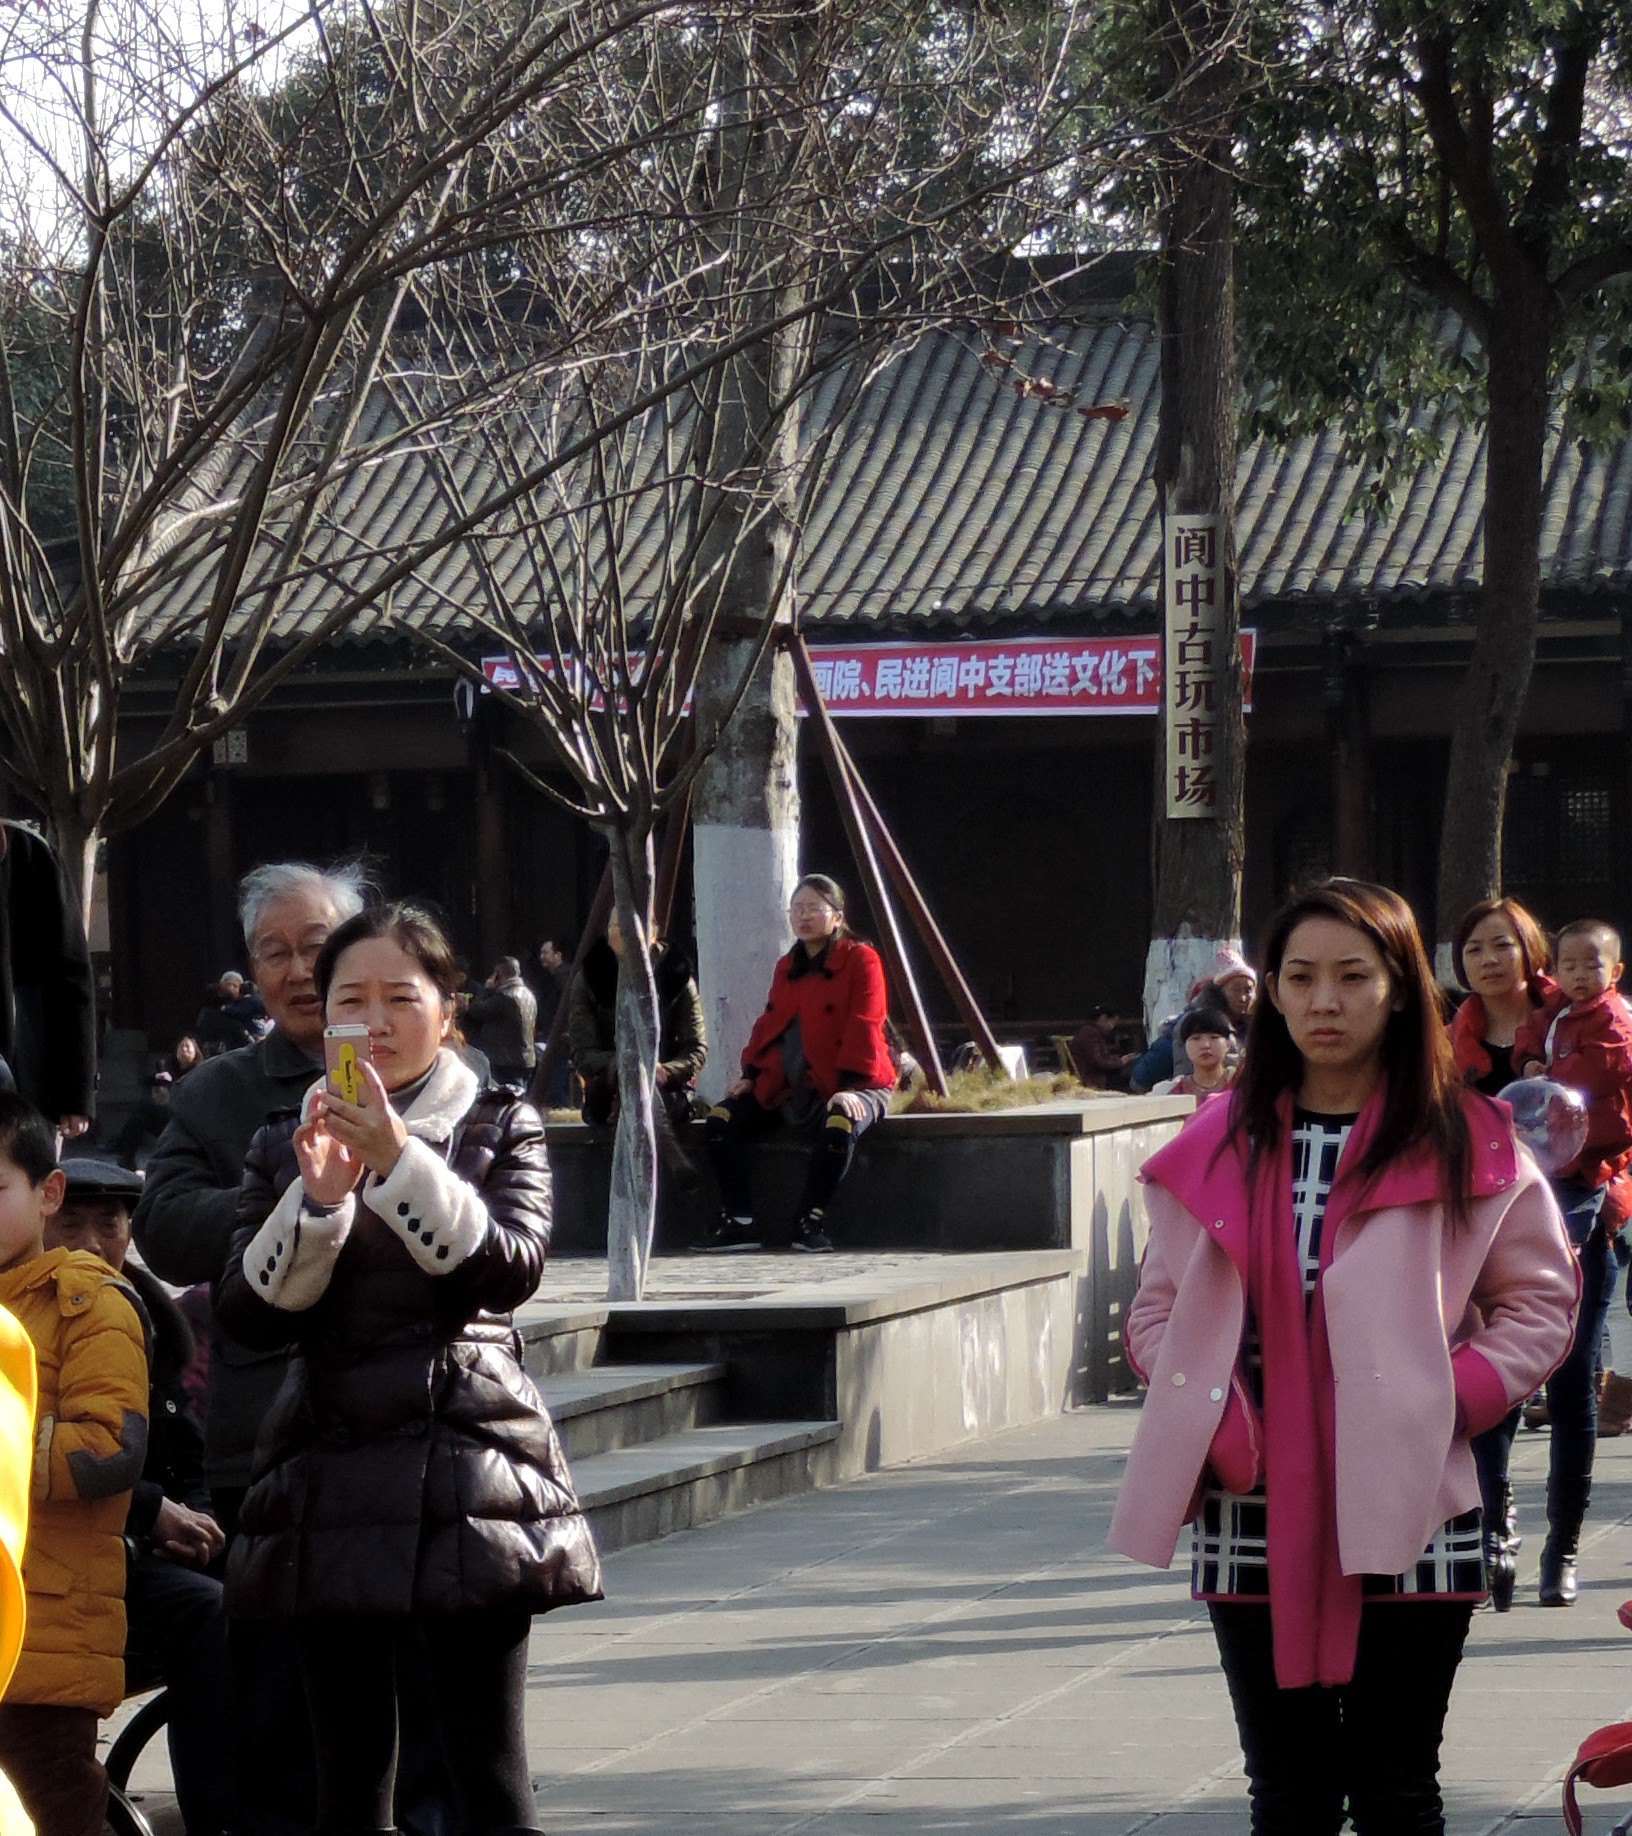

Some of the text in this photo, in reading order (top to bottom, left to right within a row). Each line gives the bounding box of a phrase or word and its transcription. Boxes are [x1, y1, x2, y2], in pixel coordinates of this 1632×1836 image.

[812, 649, 1159, 702] 画院、民进阆中支部送文化下
[1174, 525, 1217, 808] 阆中古玩市场
